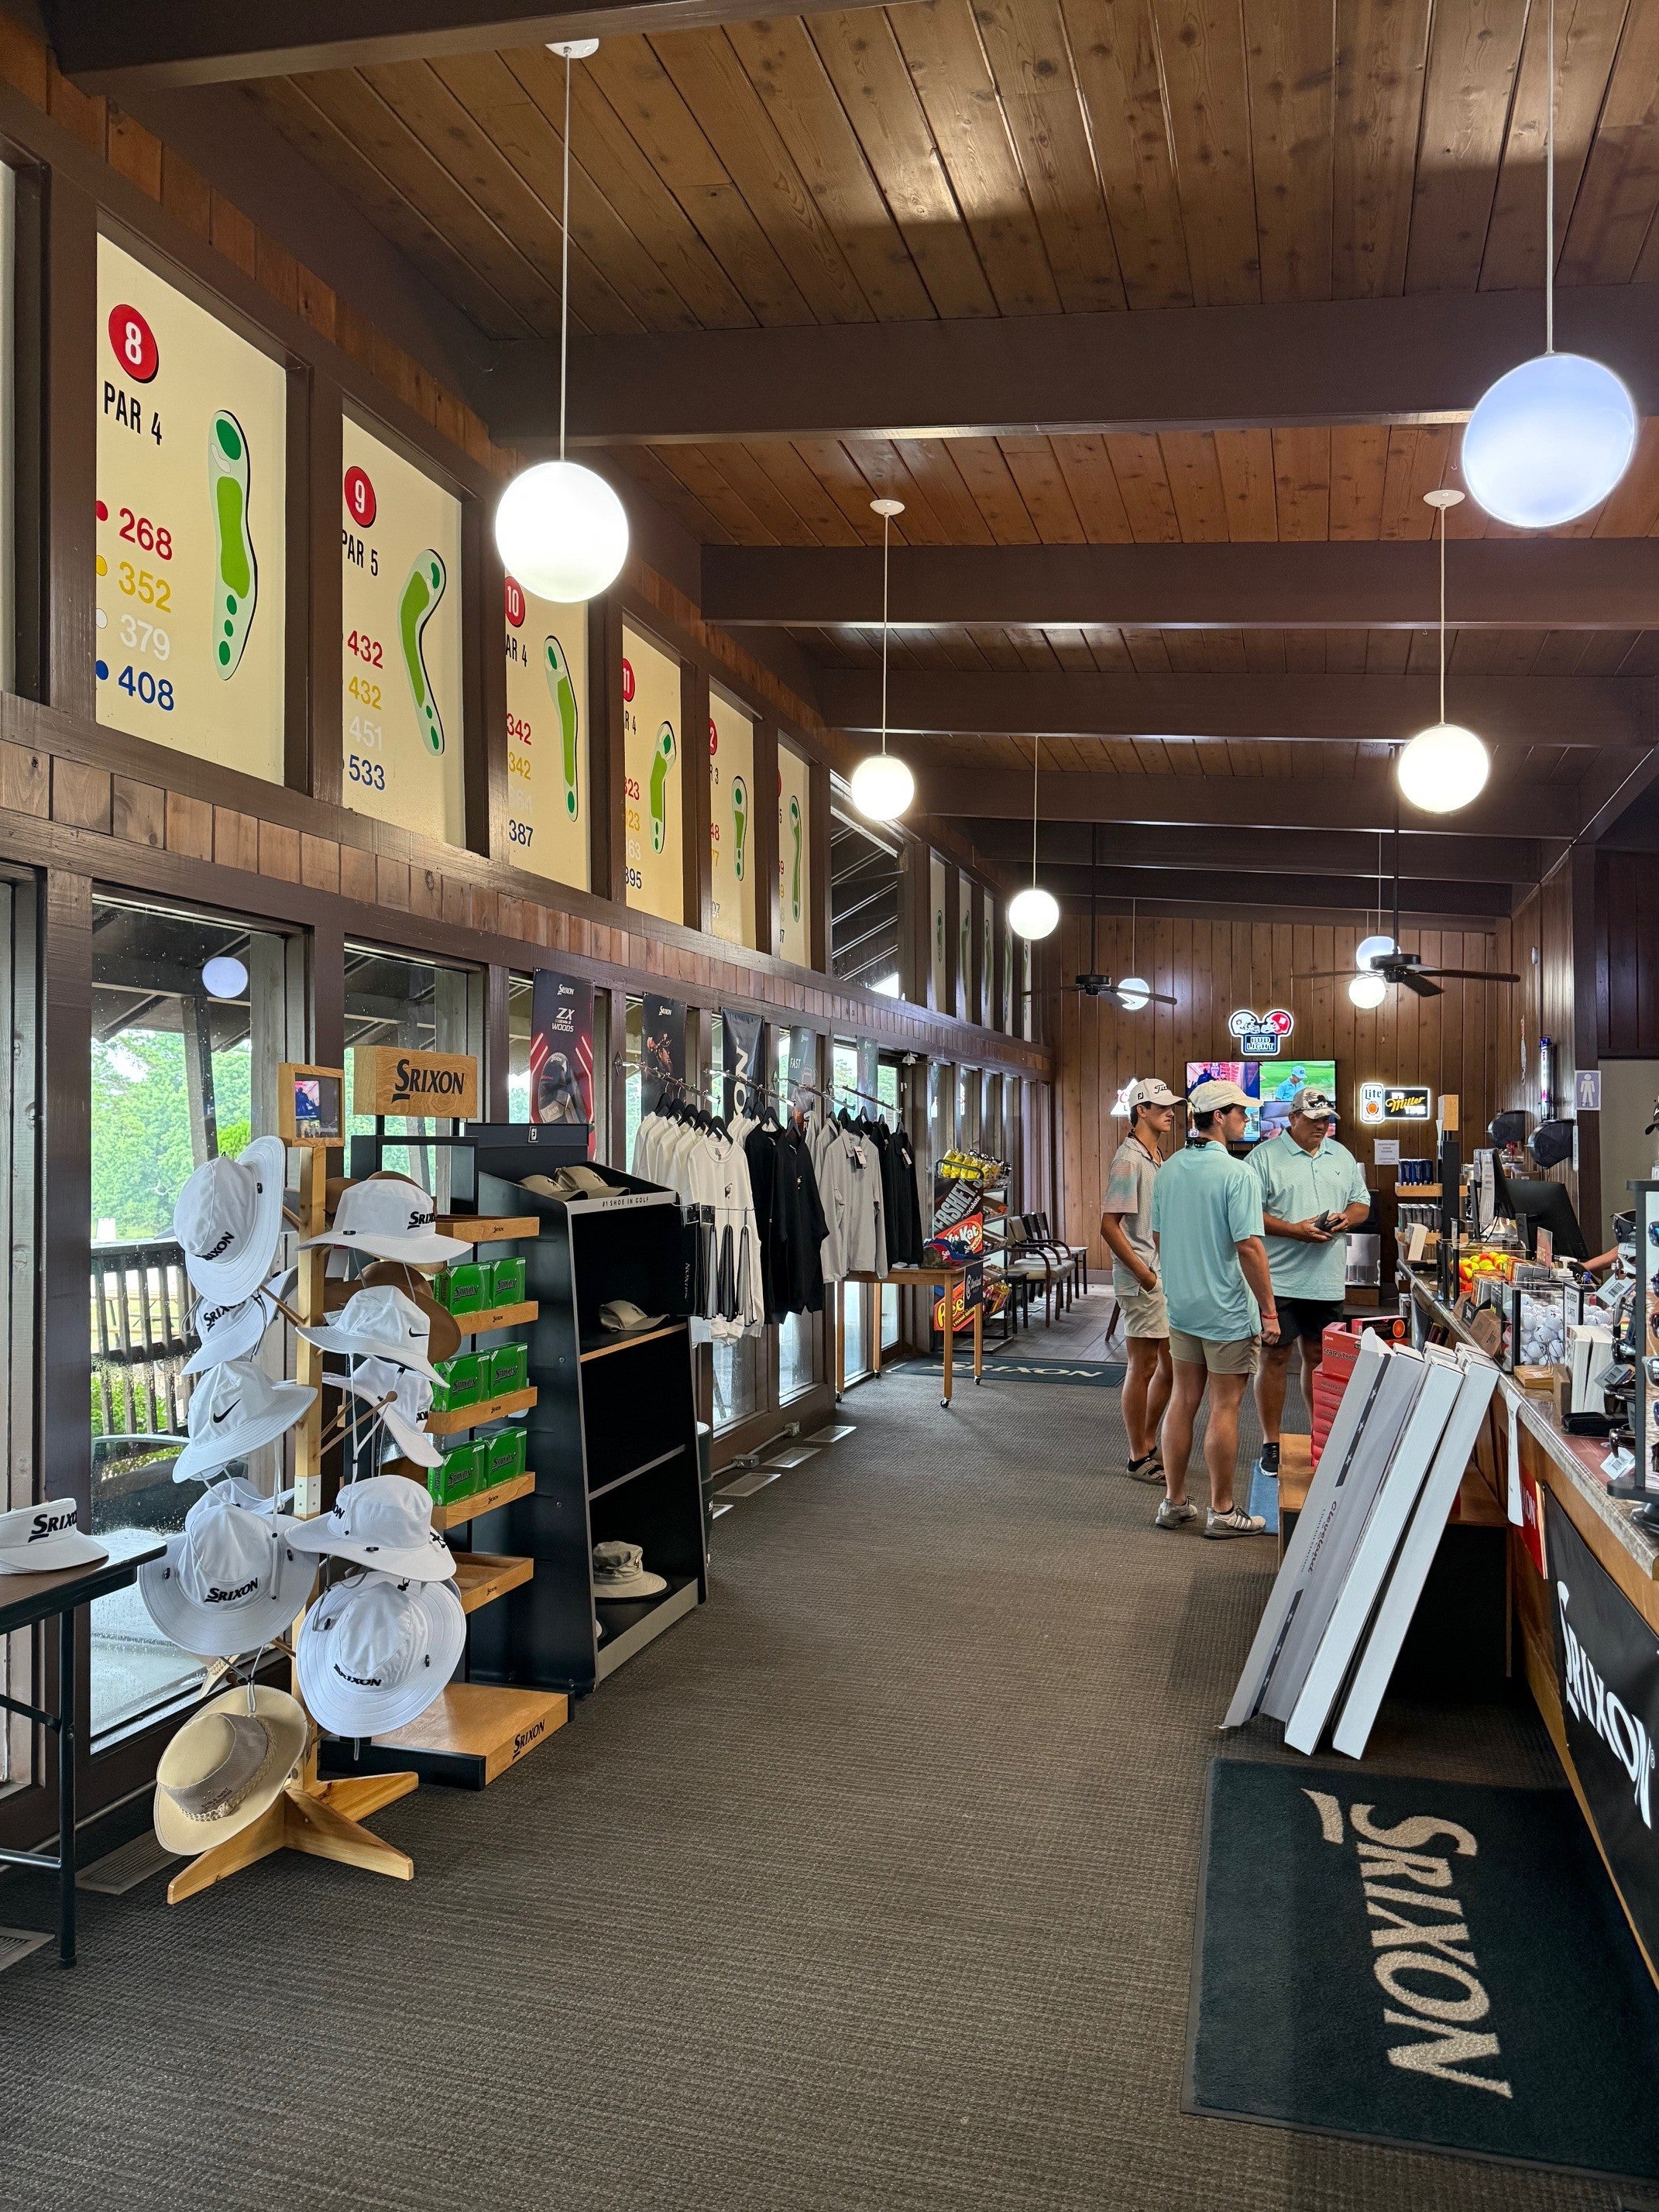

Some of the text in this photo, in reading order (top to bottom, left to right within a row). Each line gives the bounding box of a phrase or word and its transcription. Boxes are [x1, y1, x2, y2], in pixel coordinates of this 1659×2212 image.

[125, 321, 143, 366] 8
[103, 380, 163, 447] PAR 4
[354, 479, 366, 513] 9
[118, 507, 173, 562] 268
[370, 548, 378, 576] 5
[118, 561, 172, 614] 352
[507, 584, 520, 617] 10
[119, 613, 171, 661] 379
[347, 630, 383, 669] 432
[521, 644, 527, 667] 4
[118, 665, 175, 712] 408
[348, 676, 382, 711] 432
[349, 715, 383, 753] 451
[506, 713, 532, 746] 342
[349, 754, 386, 792] 533
[508, 751, 531, 781] 342
[509, 819, 534, 847] 387
[551, 1022, 574, 1032] WOODS
[556, 1007, 575, 1021] ZX
[393, 1059, 465, 1097] SRIXON
[1365, 1089, 1382, 1100] Lite
[1385, 1096, 1426, 1113] Miller
[204, 1577, 258, 1602] SRIXON
[1557, 1580, 1652, 1829] SRIXON
[514, 1719, 545, 1754] SRIXON
[1345, 1802, 1513, 2098] SRIXON
